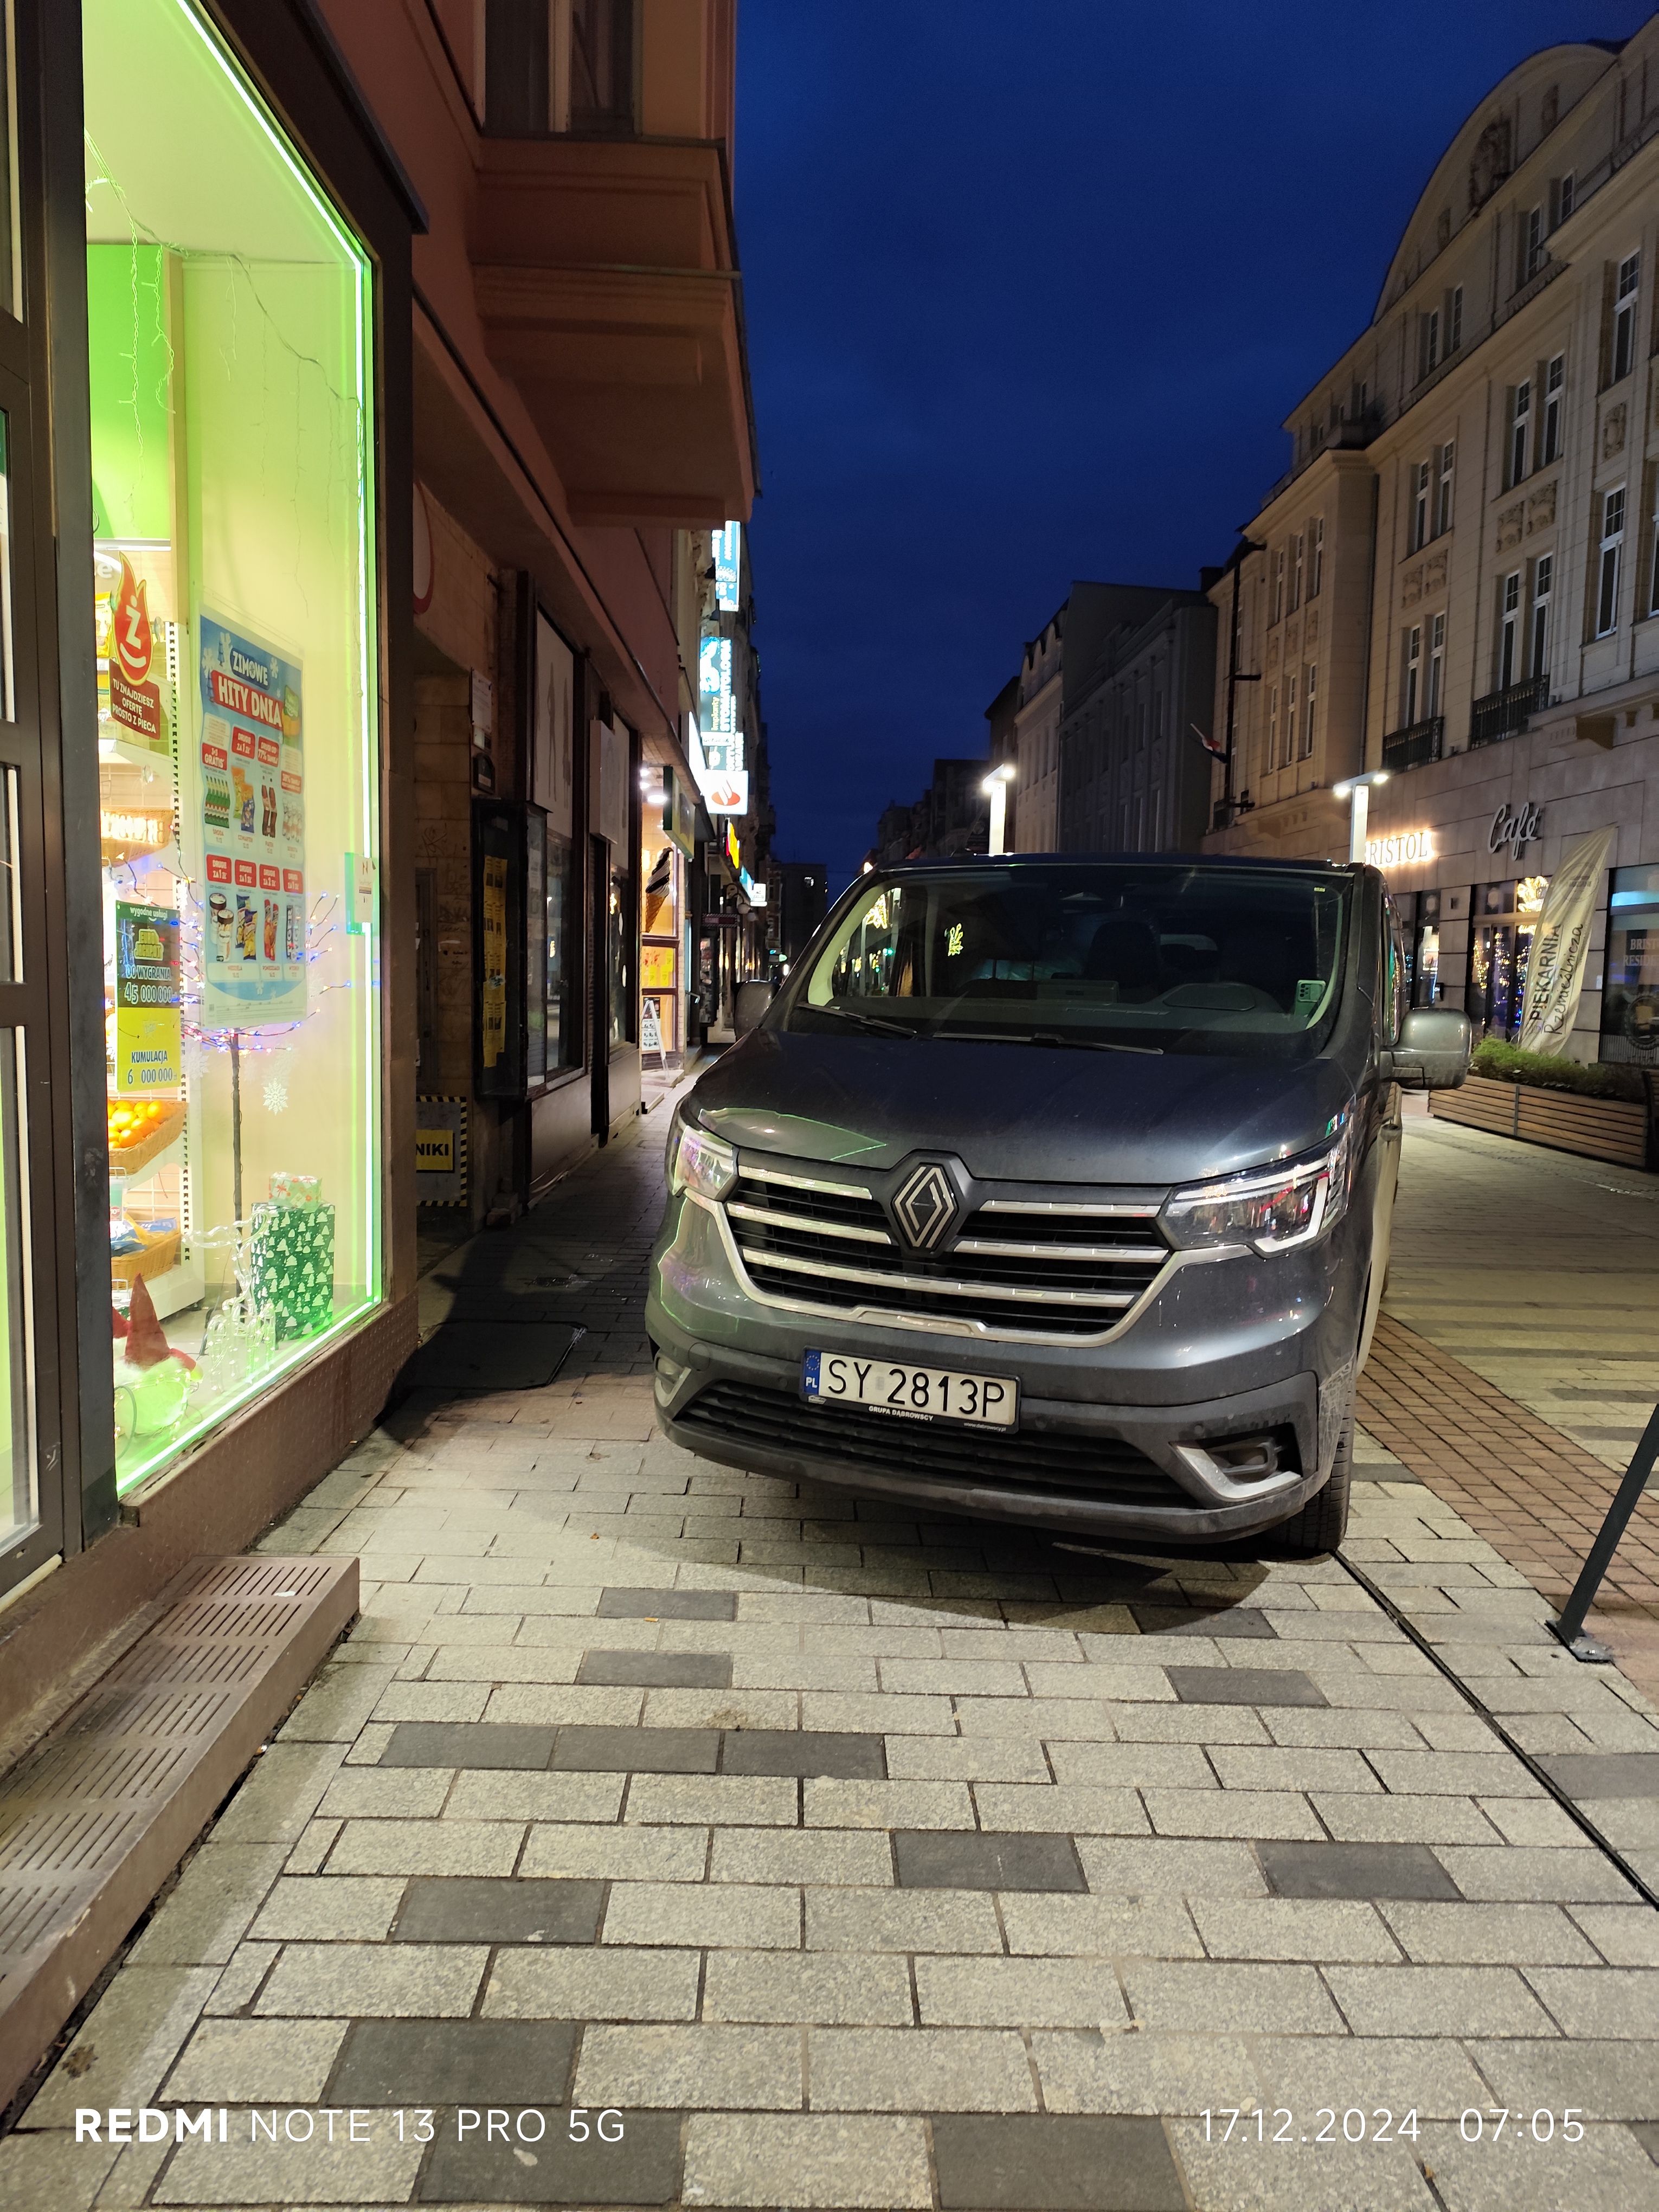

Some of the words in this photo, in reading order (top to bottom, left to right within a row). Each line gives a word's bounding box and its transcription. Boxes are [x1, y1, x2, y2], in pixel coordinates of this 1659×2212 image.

[233, 651, 268, 686] ZIMOWE
[113, 678, 119, 690] TU
[120, 683, 155, 709] ZNAJDZIESZ
[218, 676, 248, 712] HITY
[251, 691, 282, 728] DNIA
[112, 703, 132, 723] PROSTO
[132, 715, 137, 725] Z
[138, 718, 157, 734] PIECA
[122, 697, 143, 718] OFERTĘ
[1488, 801, 1540, 861] Café
[1365, 832, 1428, 865] RISTOL
[130, 906, 152, 917] wygodne
[136, 965, 172, 981] WYGRANIA
[1529, 923, 1561, 1021] PIEKARNIA
[124, 982, 139, 1005] 45
[140, 985, 157, 1003] 000
[157, 986, 173, 1004] 000
[131, 1050, 168, 1064] KUMULACJA
[127, 1068, 133, 1085] 6
[141, 1069, 157, 1084] 000
[158, 1068, 173, 1082] 000
[416, 1143, 448, 1156] NIKI
[806, 1377, 818, 1388] PL
[828, 1359, 872, 1398] SY
[887, 1368, 1005, 1417] 2813P
[869, 1406, 891, 1416] GRUPA
[892, 1410, 934, 1422] DĄBROWSCY
